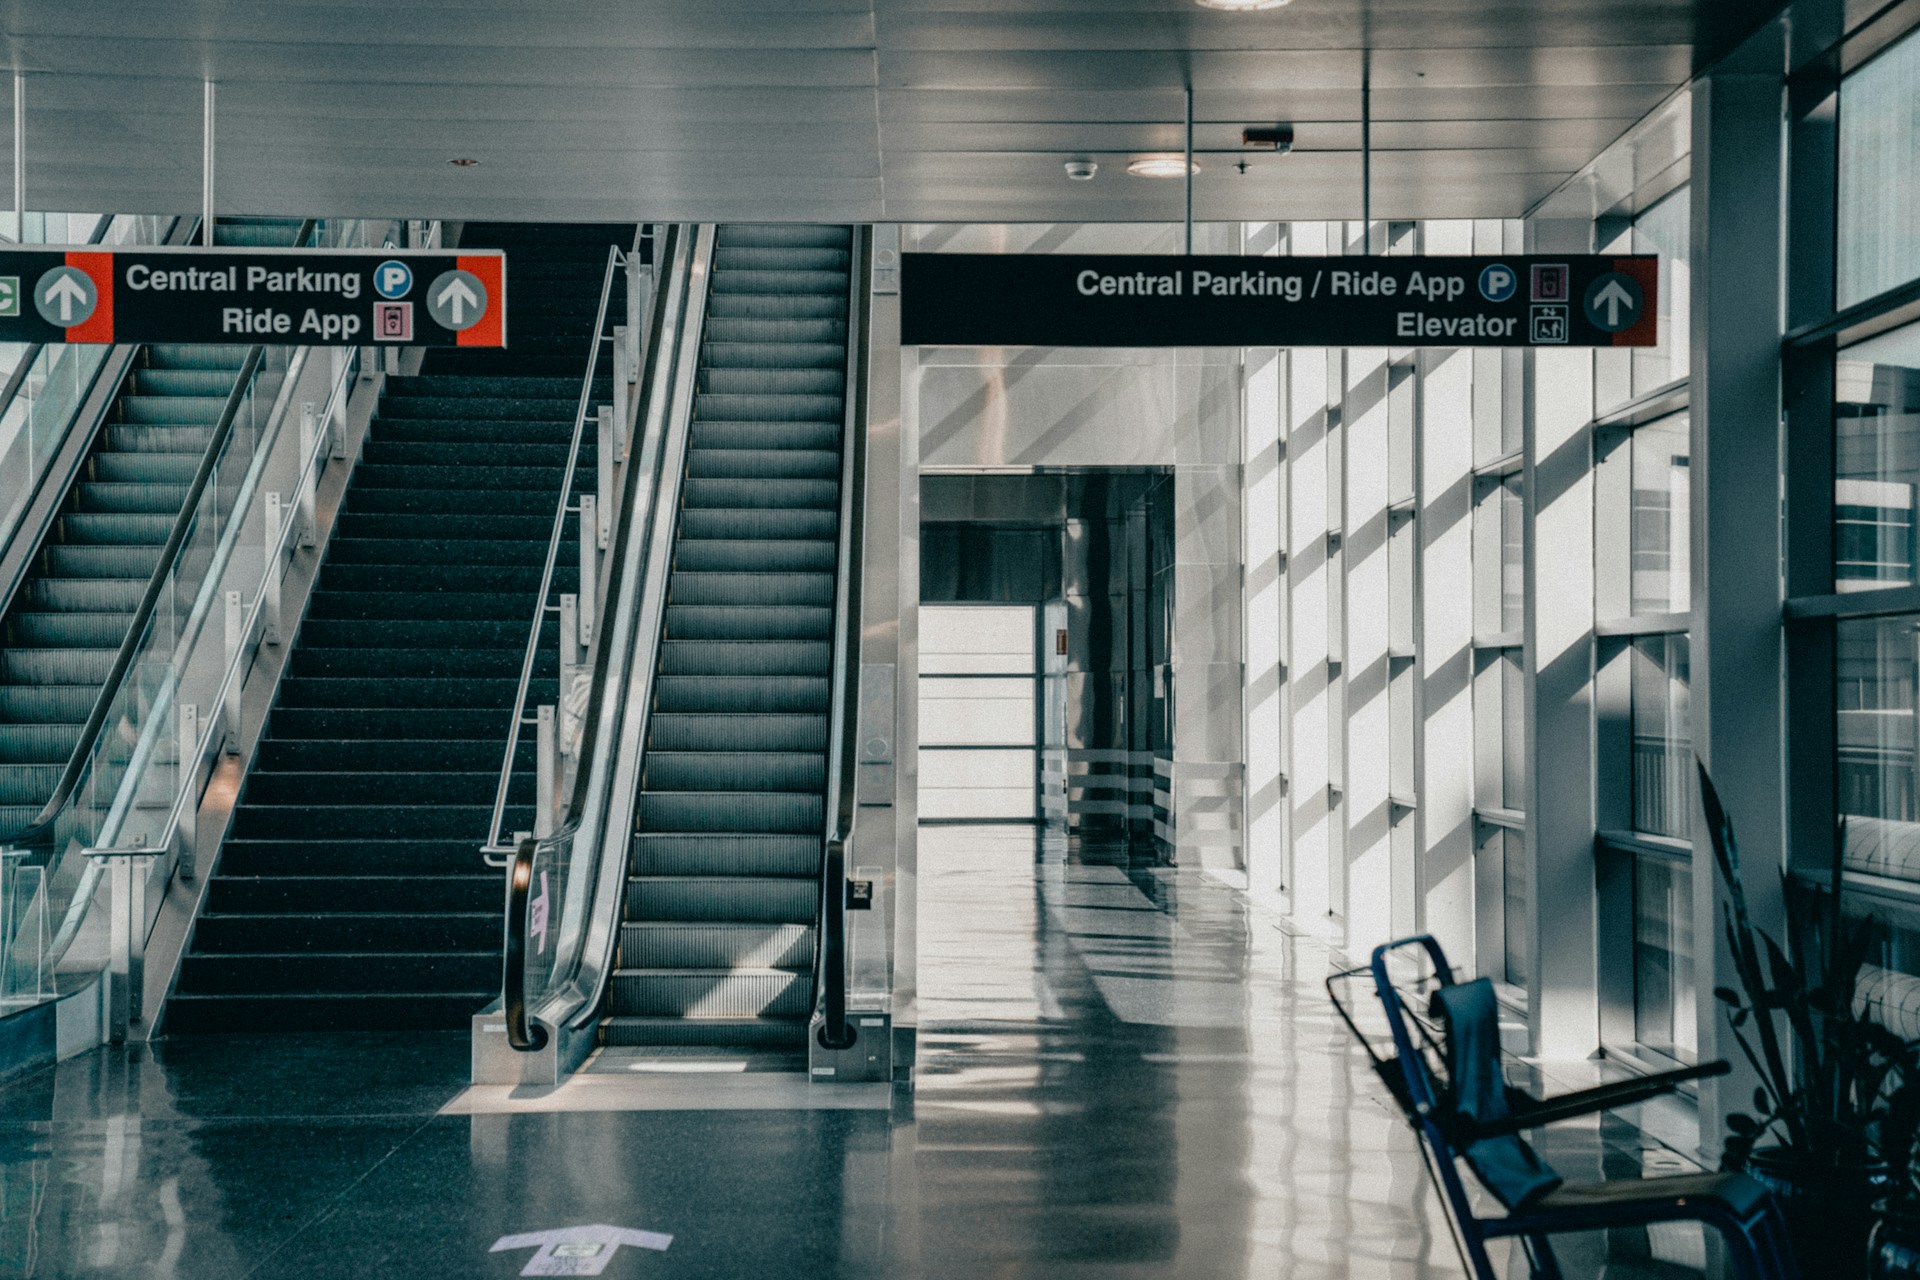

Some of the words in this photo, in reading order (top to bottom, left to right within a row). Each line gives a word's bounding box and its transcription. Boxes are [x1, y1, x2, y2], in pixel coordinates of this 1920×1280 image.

[126, 264, 236, 291] Central
[247, 266, 361, 299] Parking
[383, 267, 407, 292] P
[1076, 270, 1182, 296] Central
[1193, 270, 1303, 303] Parking
[1310, 270, 1322, 298] /
[1331, 271, 1398, 296] Ride
[1405, 271, 1466, 302] App
[1488, 270, 1511, 295] P
[223, 308, 292, 334] Ride
[299, 308, 362, 340] App
[1397, 312, 1518, 337] Elevator
